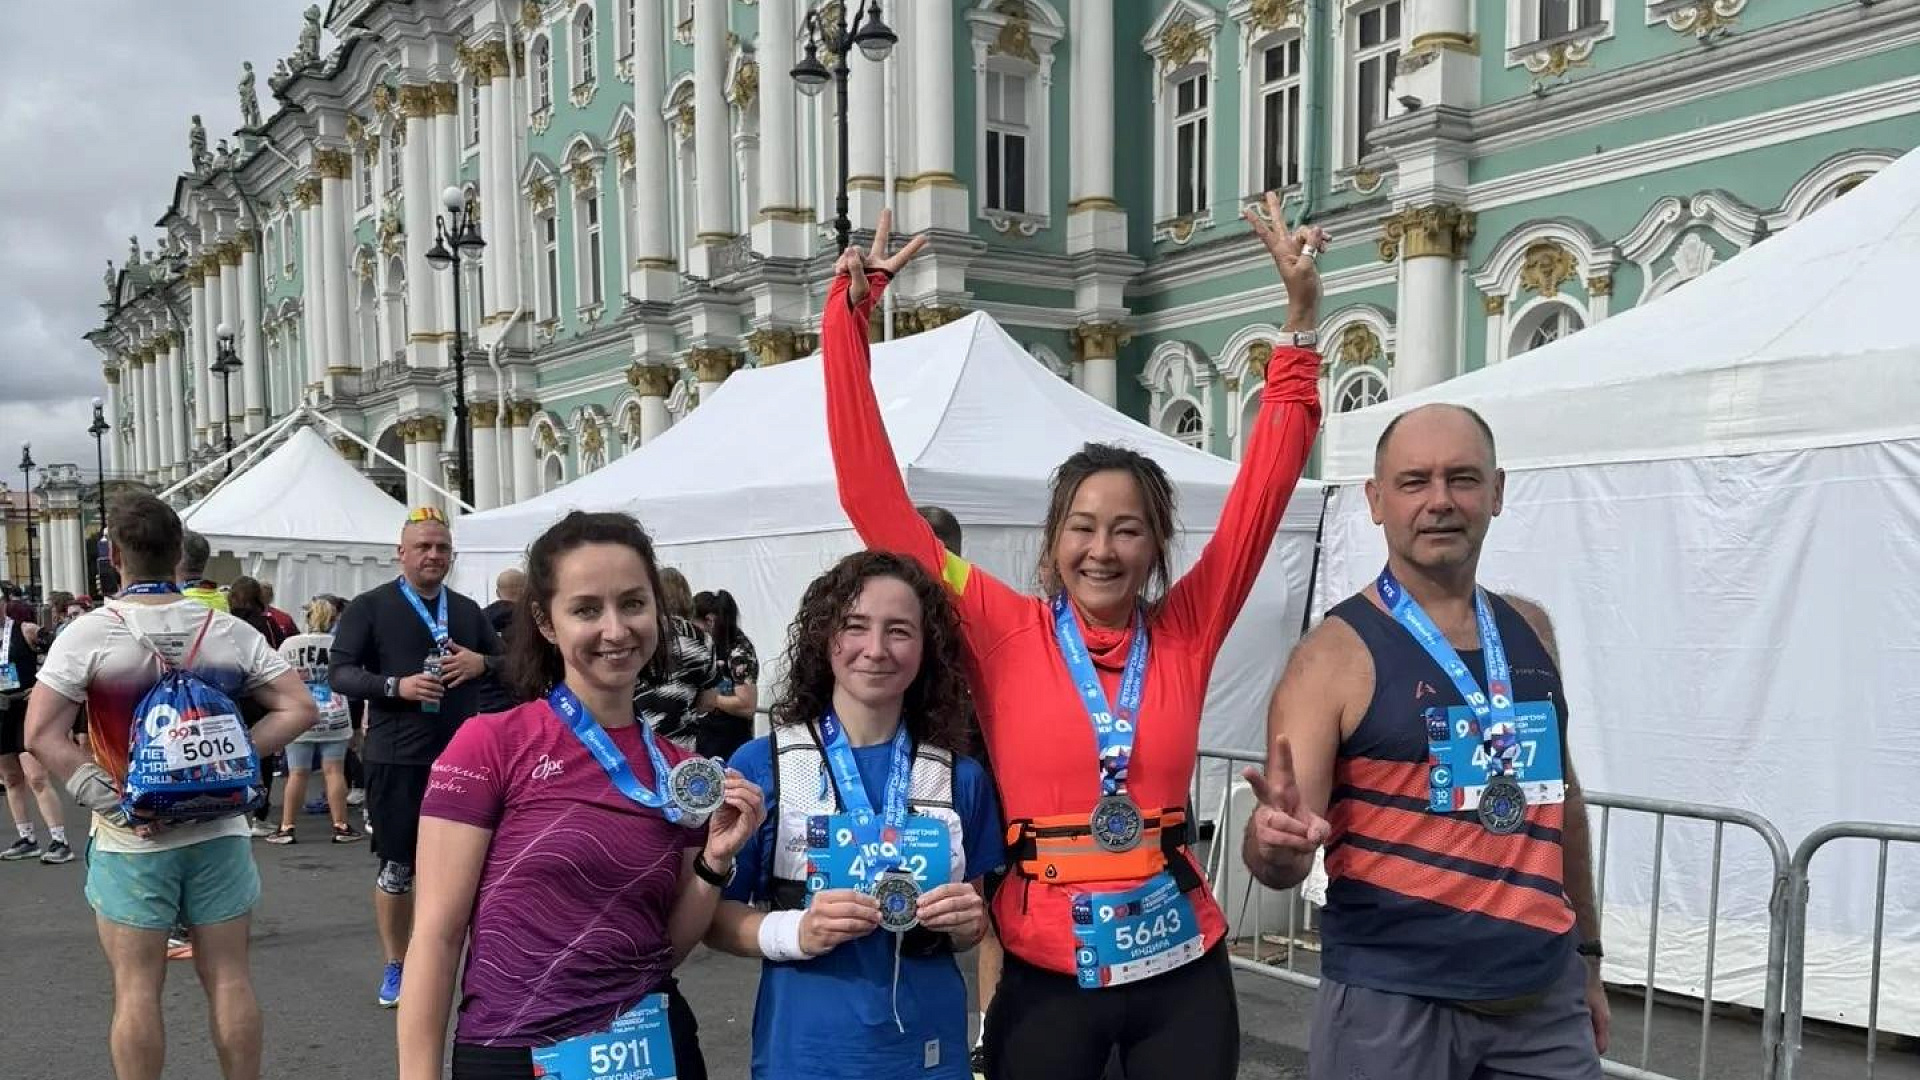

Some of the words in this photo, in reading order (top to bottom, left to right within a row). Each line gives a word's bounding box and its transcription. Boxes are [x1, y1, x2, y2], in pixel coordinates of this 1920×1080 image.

[1092, 712, 1112, 725] 10
[183, 736, 235, 761] 5016
[811, 879, 825, 890] D
[1115, 908, 1181, 949] 5643
[1080, 950, 1093, 963] D
[1131, 938, 1170, 958] ИНДИРА
[590, 1036, 651, 1074] 5911
